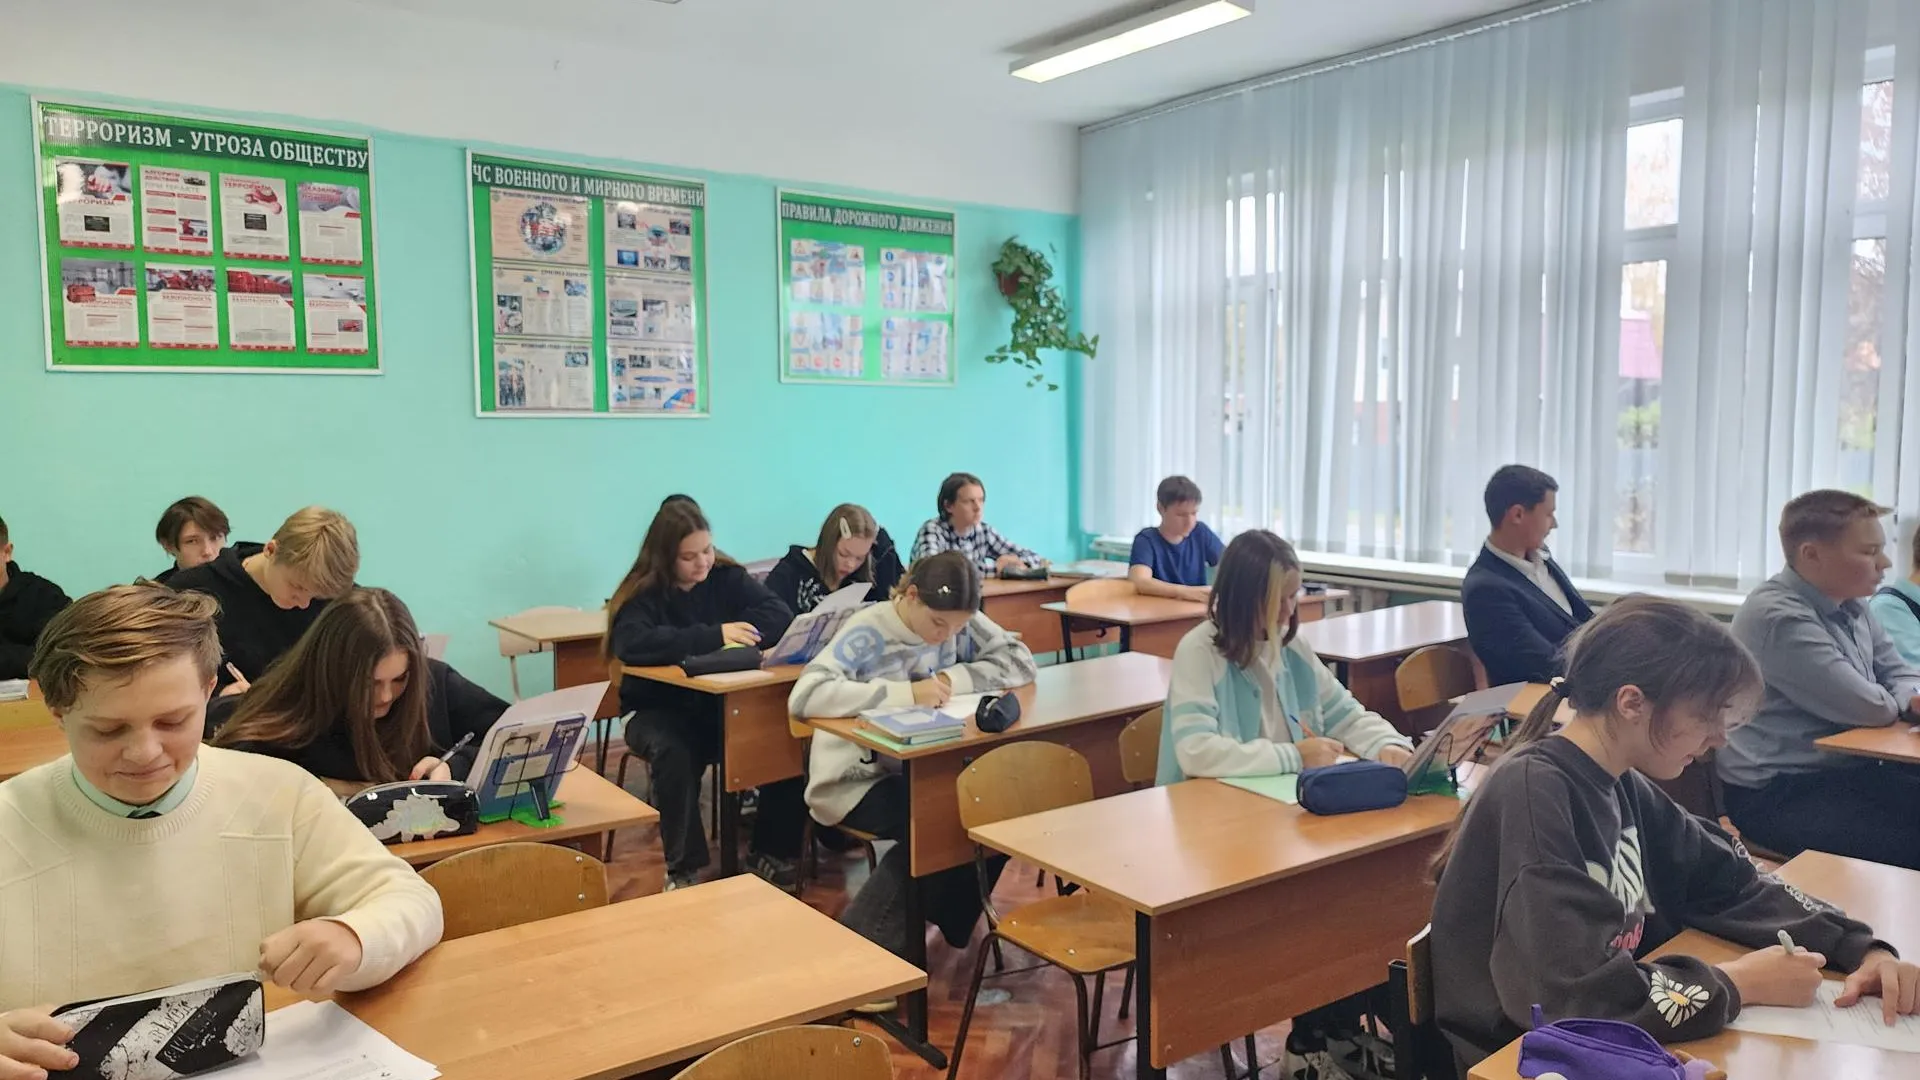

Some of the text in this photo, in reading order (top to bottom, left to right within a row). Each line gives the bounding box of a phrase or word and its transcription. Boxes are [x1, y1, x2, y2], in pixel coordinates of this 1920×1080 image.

[44, 116, 171, 147] ТЕРРОРИЗМ
[190, 131, 265, 157] УГРОЗА
[269, 140, 368, 169] ОБЩЕСТВУ
[472, 163, 491, 183] ЧС
[495, 167, 568, 192] ВОЕННОГО
[571, 176, 580, 193] И
[583, 178, 645, 200] МИРНОГО
[647, 184, 704, 207] ВРЕМЕНИ
[781, 202, 953, 236] ПРАВИЛА ДОРОЖНОГО ДВИЖЕНИЯ
